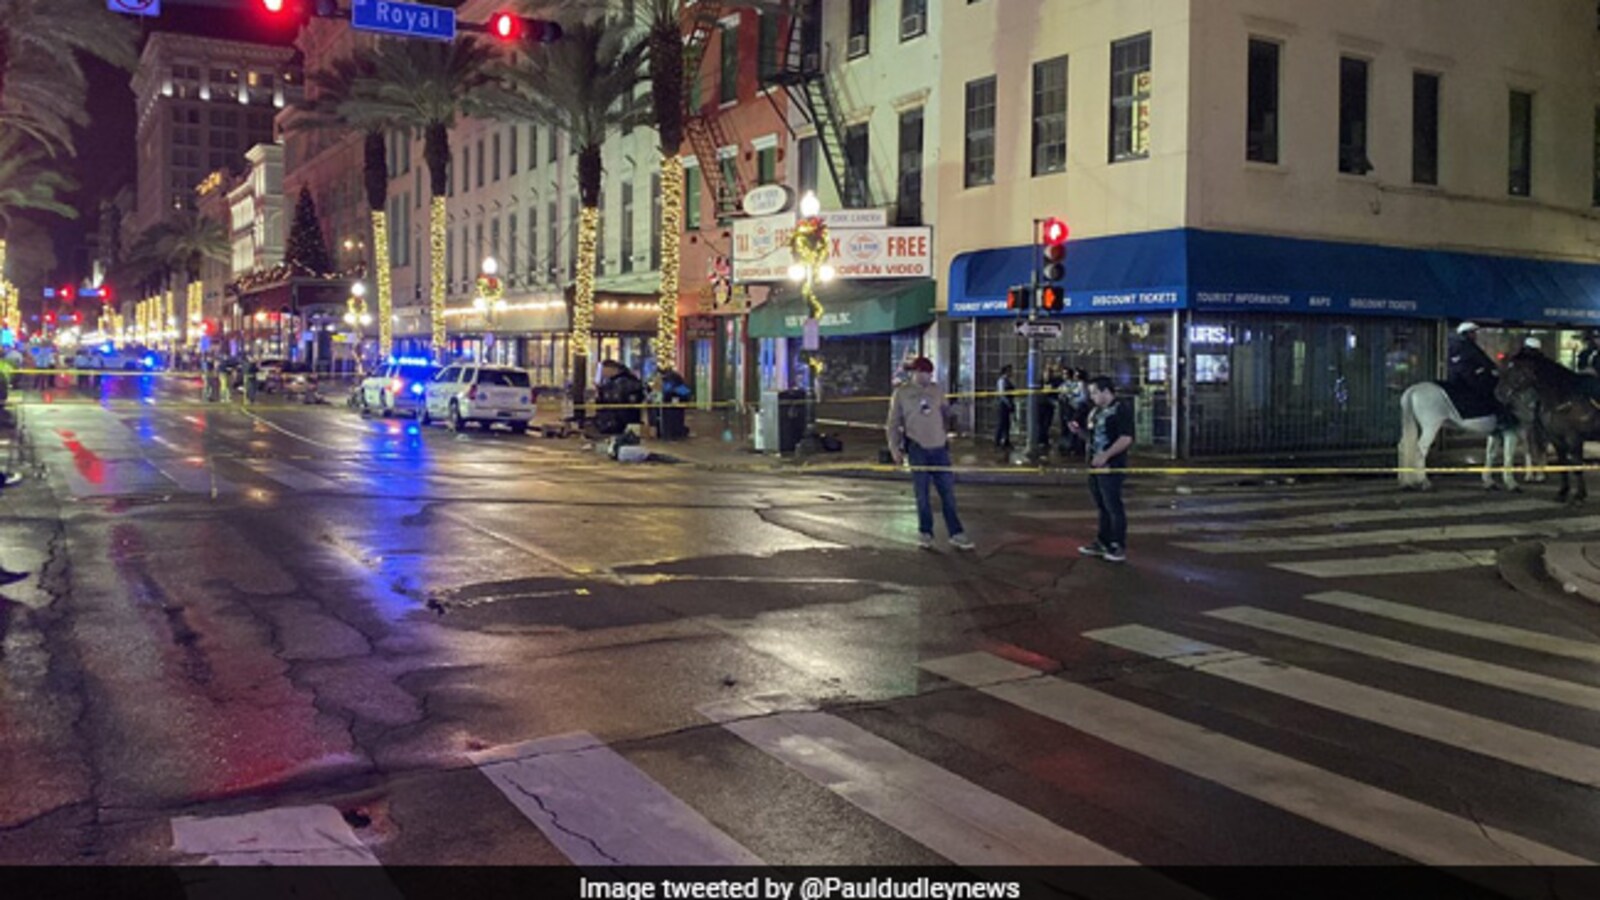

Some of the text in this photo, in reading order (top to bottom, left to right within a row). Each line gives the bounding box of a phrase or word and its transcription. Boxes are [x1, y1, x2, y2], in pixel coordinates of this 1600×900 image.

[376, 2, 439, 31] Royal
[887, 235, 926, 257] FREE
[886, 263, 924, 275] VIDEO
[1091, 291, 1178, 307] DISCOUNT TICKETS
[1196, 292, 1291, 305] TOURIST INFORMATION
[1308, 295, 1332, 307] MAPS
[1348, 297, 1387, 310] DISCOUNT
